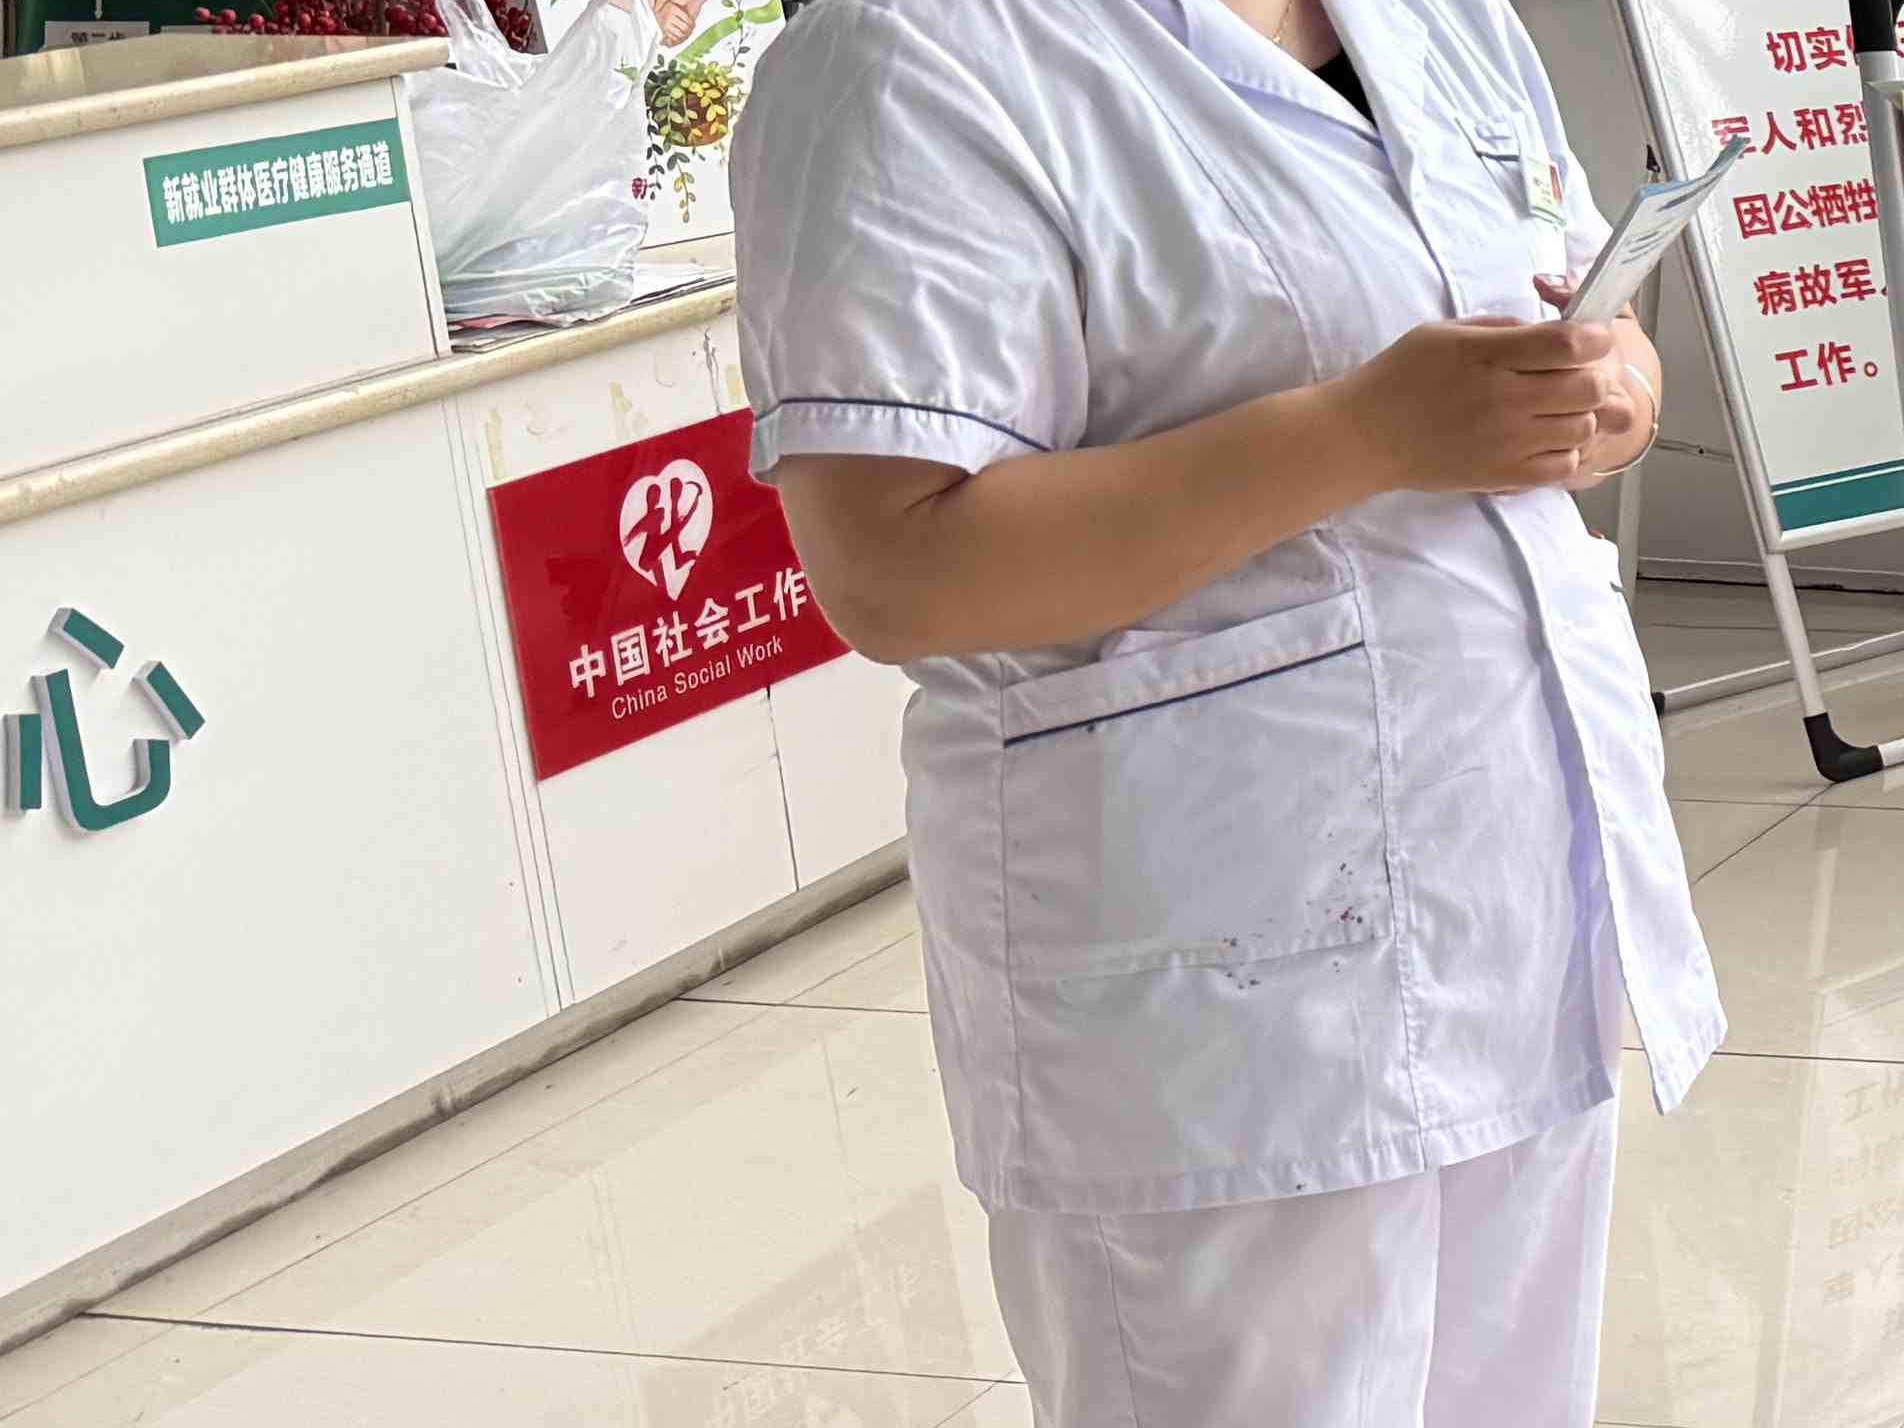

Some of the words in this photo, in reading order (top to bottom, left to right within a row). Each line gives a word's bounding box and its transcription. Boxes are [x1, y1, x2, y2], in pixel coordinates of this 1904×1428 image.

[163, 140, 394, 224] 新就业群体医疗健康服务通道
[1732, 178, 1879, 240] 因公牺牲
[1753, 258, 1888, 316] 病故军
[1775, 341, 1878, 391] 工作。
[569, 567, 808, 698] 中国社会工作
[3, 606, 206, 832] 心
[612, 684, 668, 720] China
[674, 655, 731, 694] Social
[737, 636, 783, 668] Work
